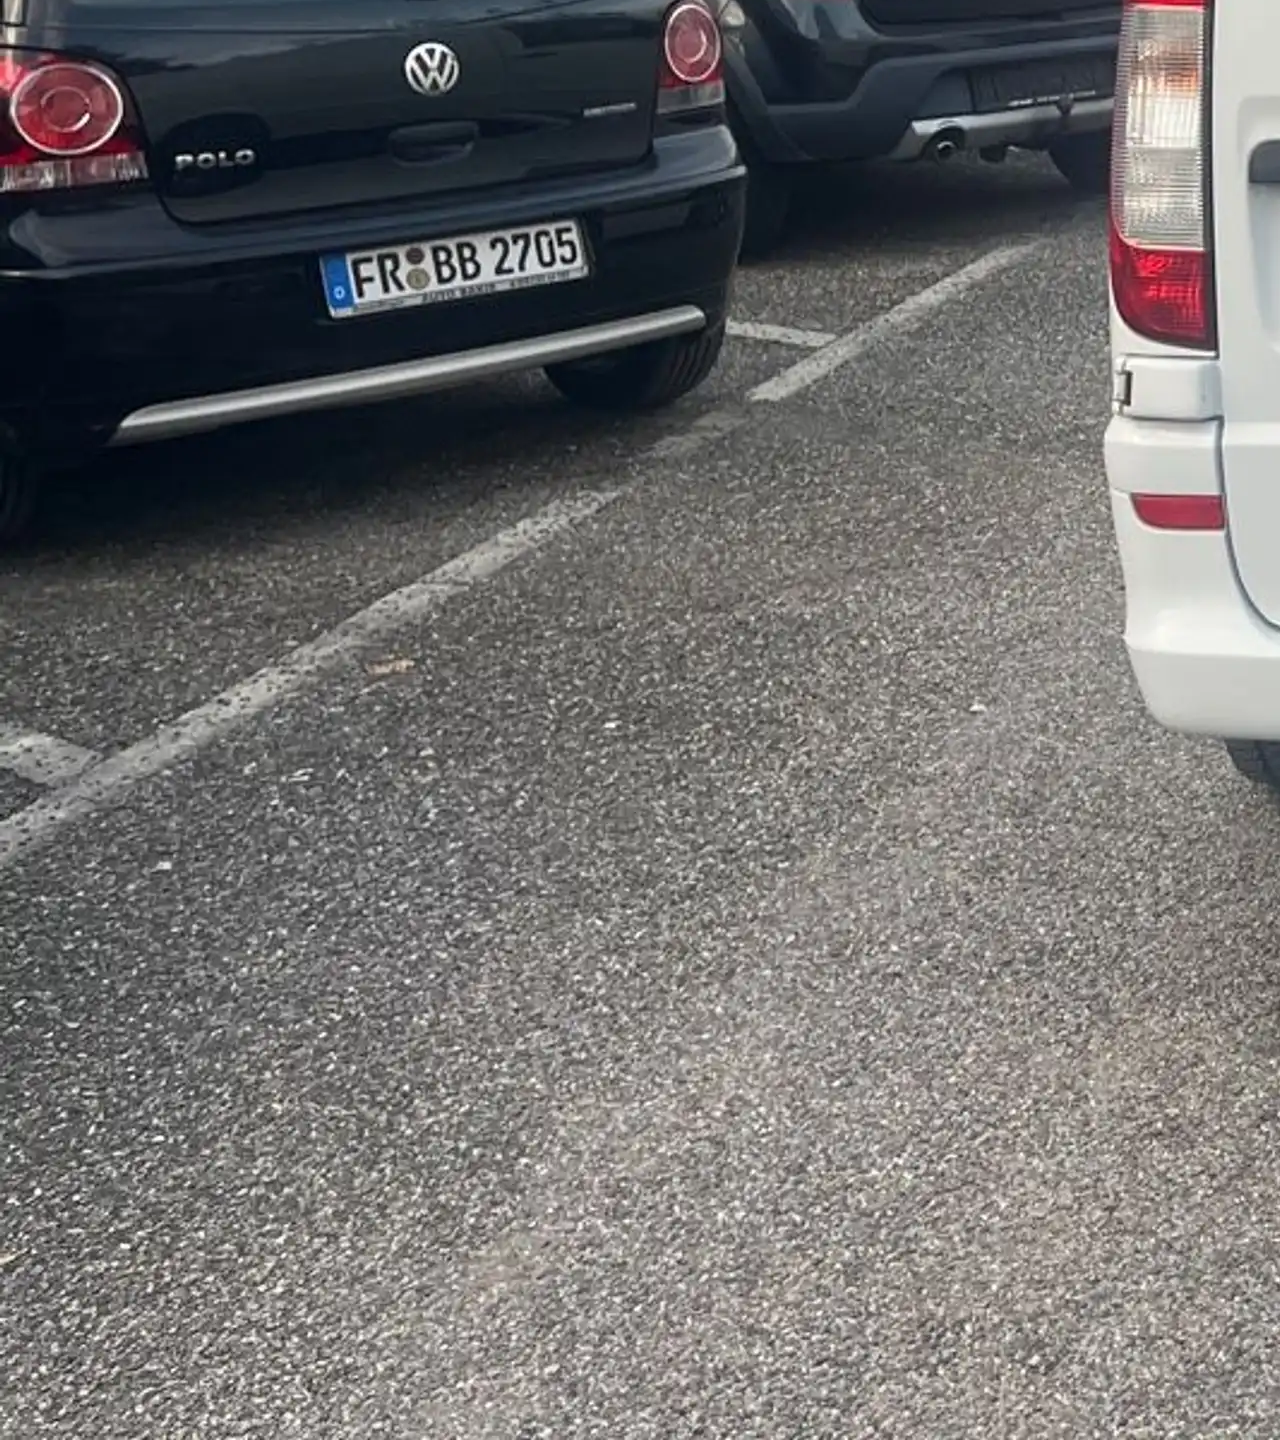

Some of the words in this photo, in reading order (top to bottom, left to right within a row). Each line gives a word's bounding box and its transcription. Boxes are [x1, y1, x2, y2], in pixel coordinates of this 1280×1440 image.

[174, 147, 256, 172] POLO
[350, 252, 405, 299] FR
[430, 240, 482, 284] BB
[488, 225, 579, 276] 2705
